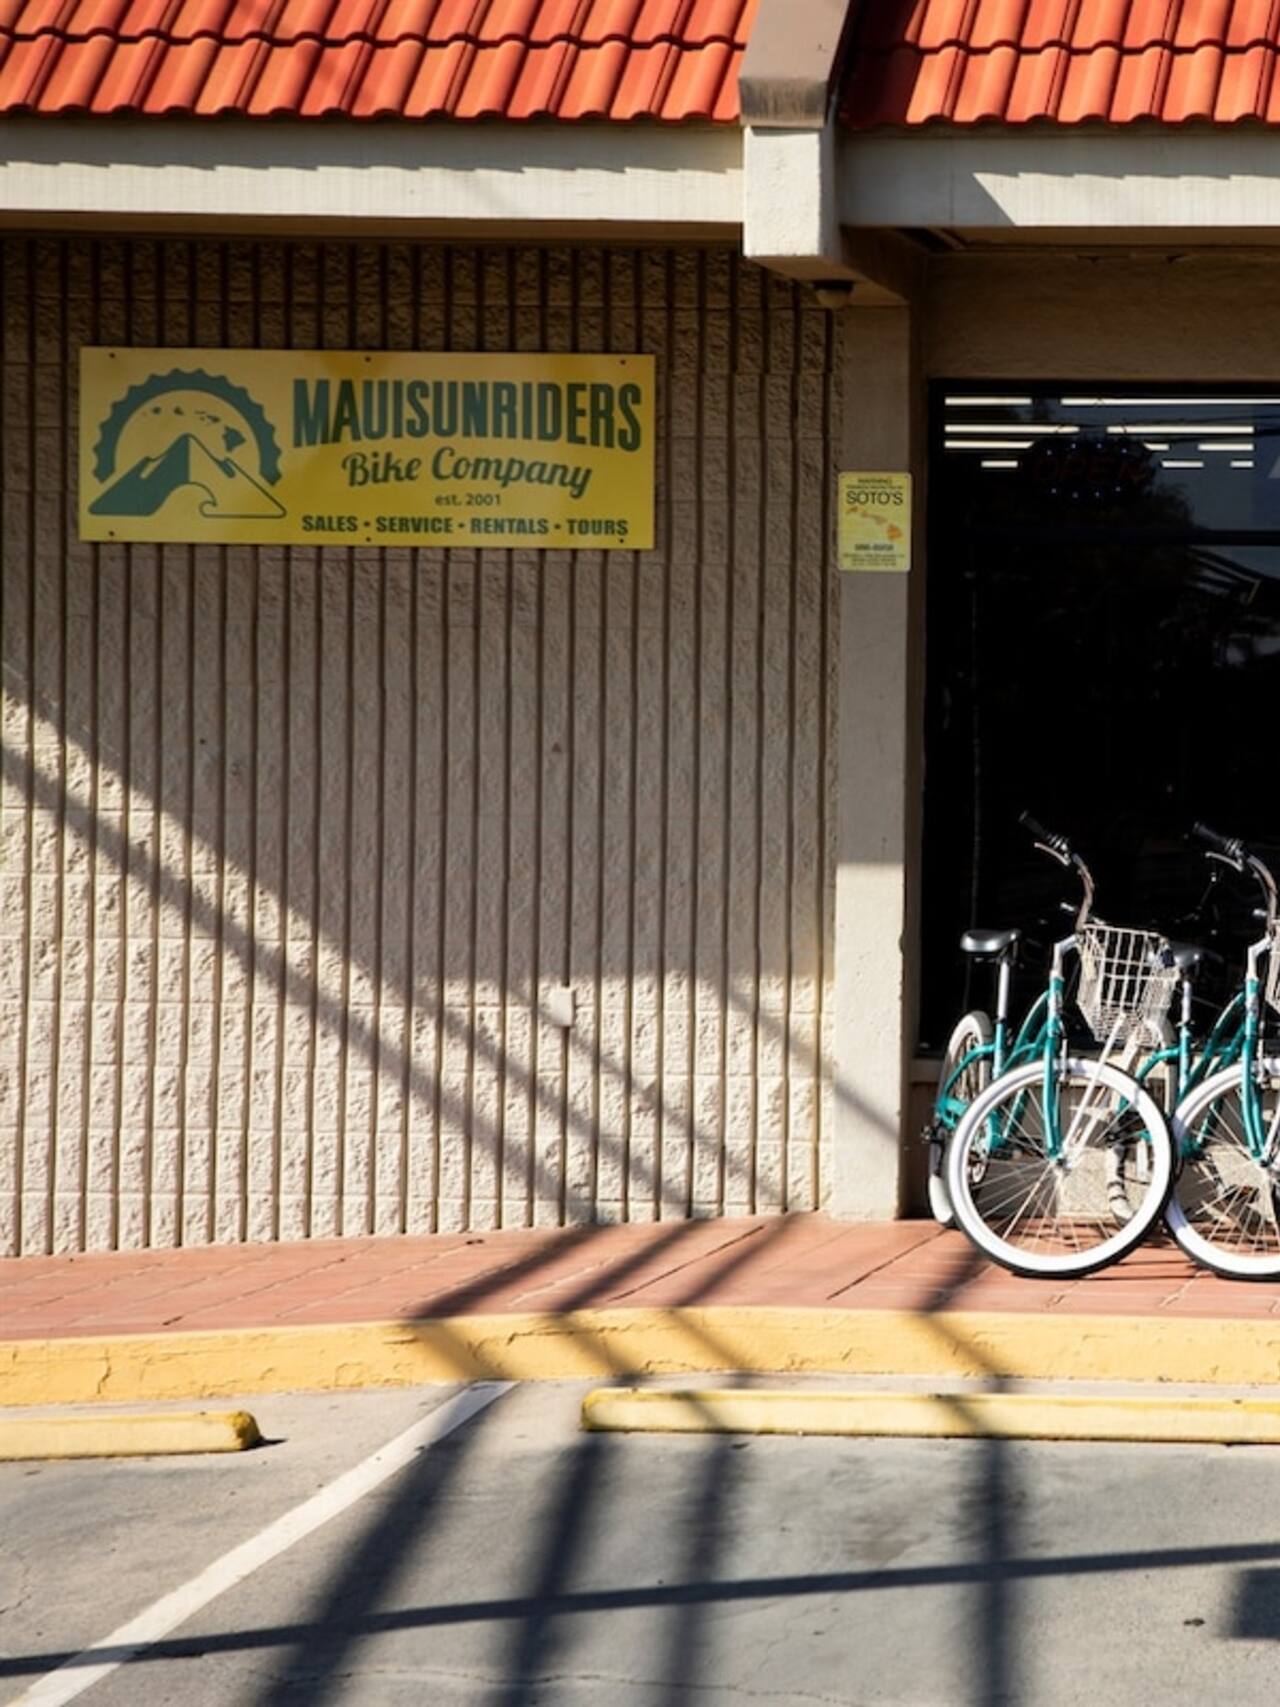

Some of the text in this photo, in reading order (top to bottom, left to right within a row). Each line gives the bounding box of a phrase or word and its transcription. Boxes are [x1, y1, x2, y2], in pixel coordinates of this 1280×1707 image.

[293, 378, 641, 451] MAUISUNRIDERS
[342, 446, 593, 499] Bike Company
[435, 493, 502, 507] est. 2001
[845, 490, 904, 506] SOTO'S
[302, 515, 629, 535] SALES SERVICE RENTALS TOURS
